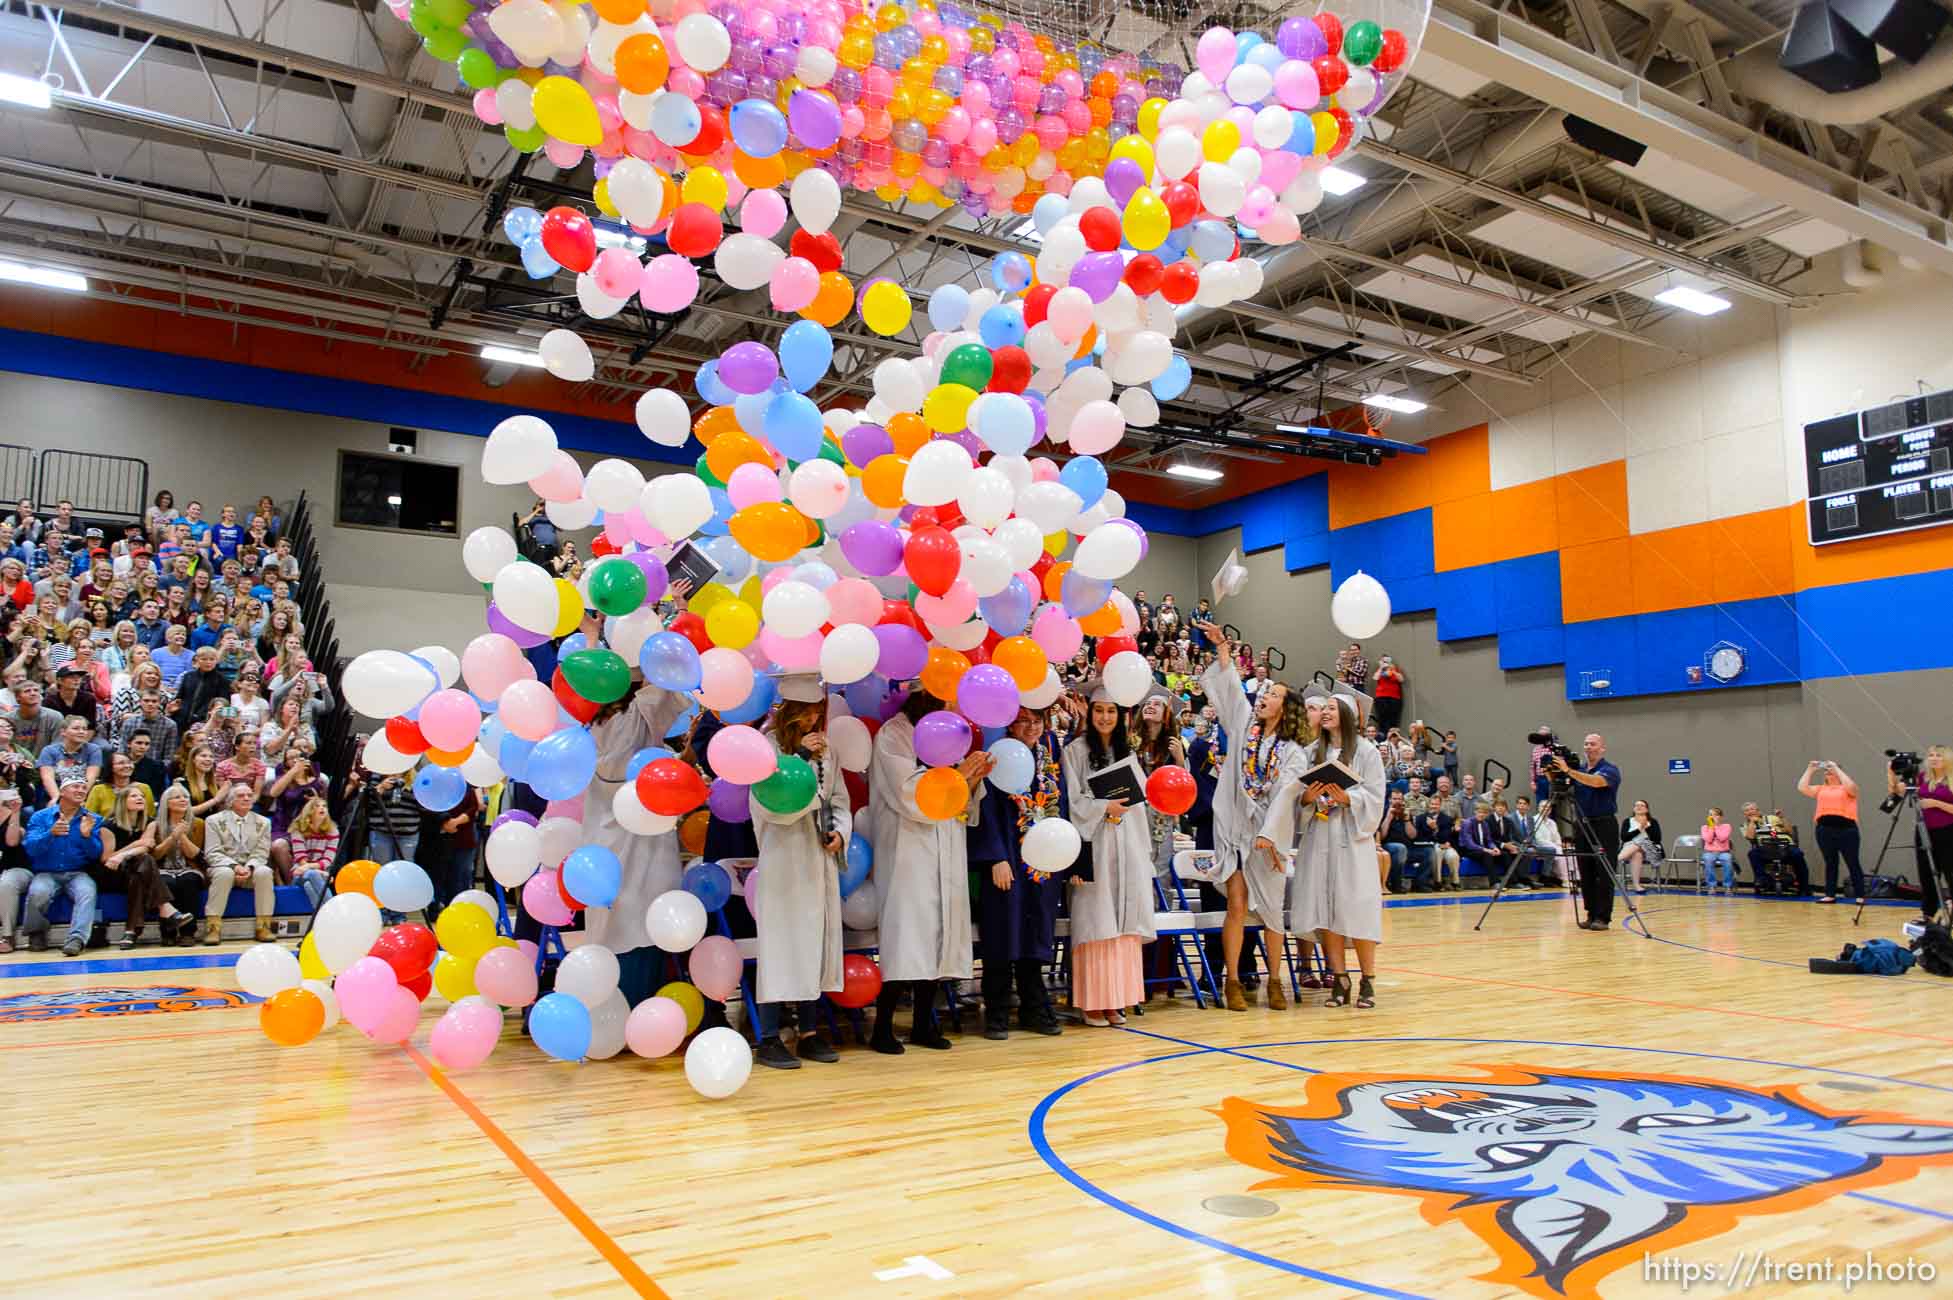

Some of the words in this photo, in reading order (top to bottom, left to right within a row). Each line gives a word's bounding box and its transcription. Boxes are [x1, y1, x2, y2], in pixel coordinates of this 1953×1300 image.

[1822, 444, 1858, 463] HOME
[1883, 481, 1921, 498] PLAYER
[1930, 475, 1953, 489] FOU
[1826, 494, 1856, 508] FOULS
